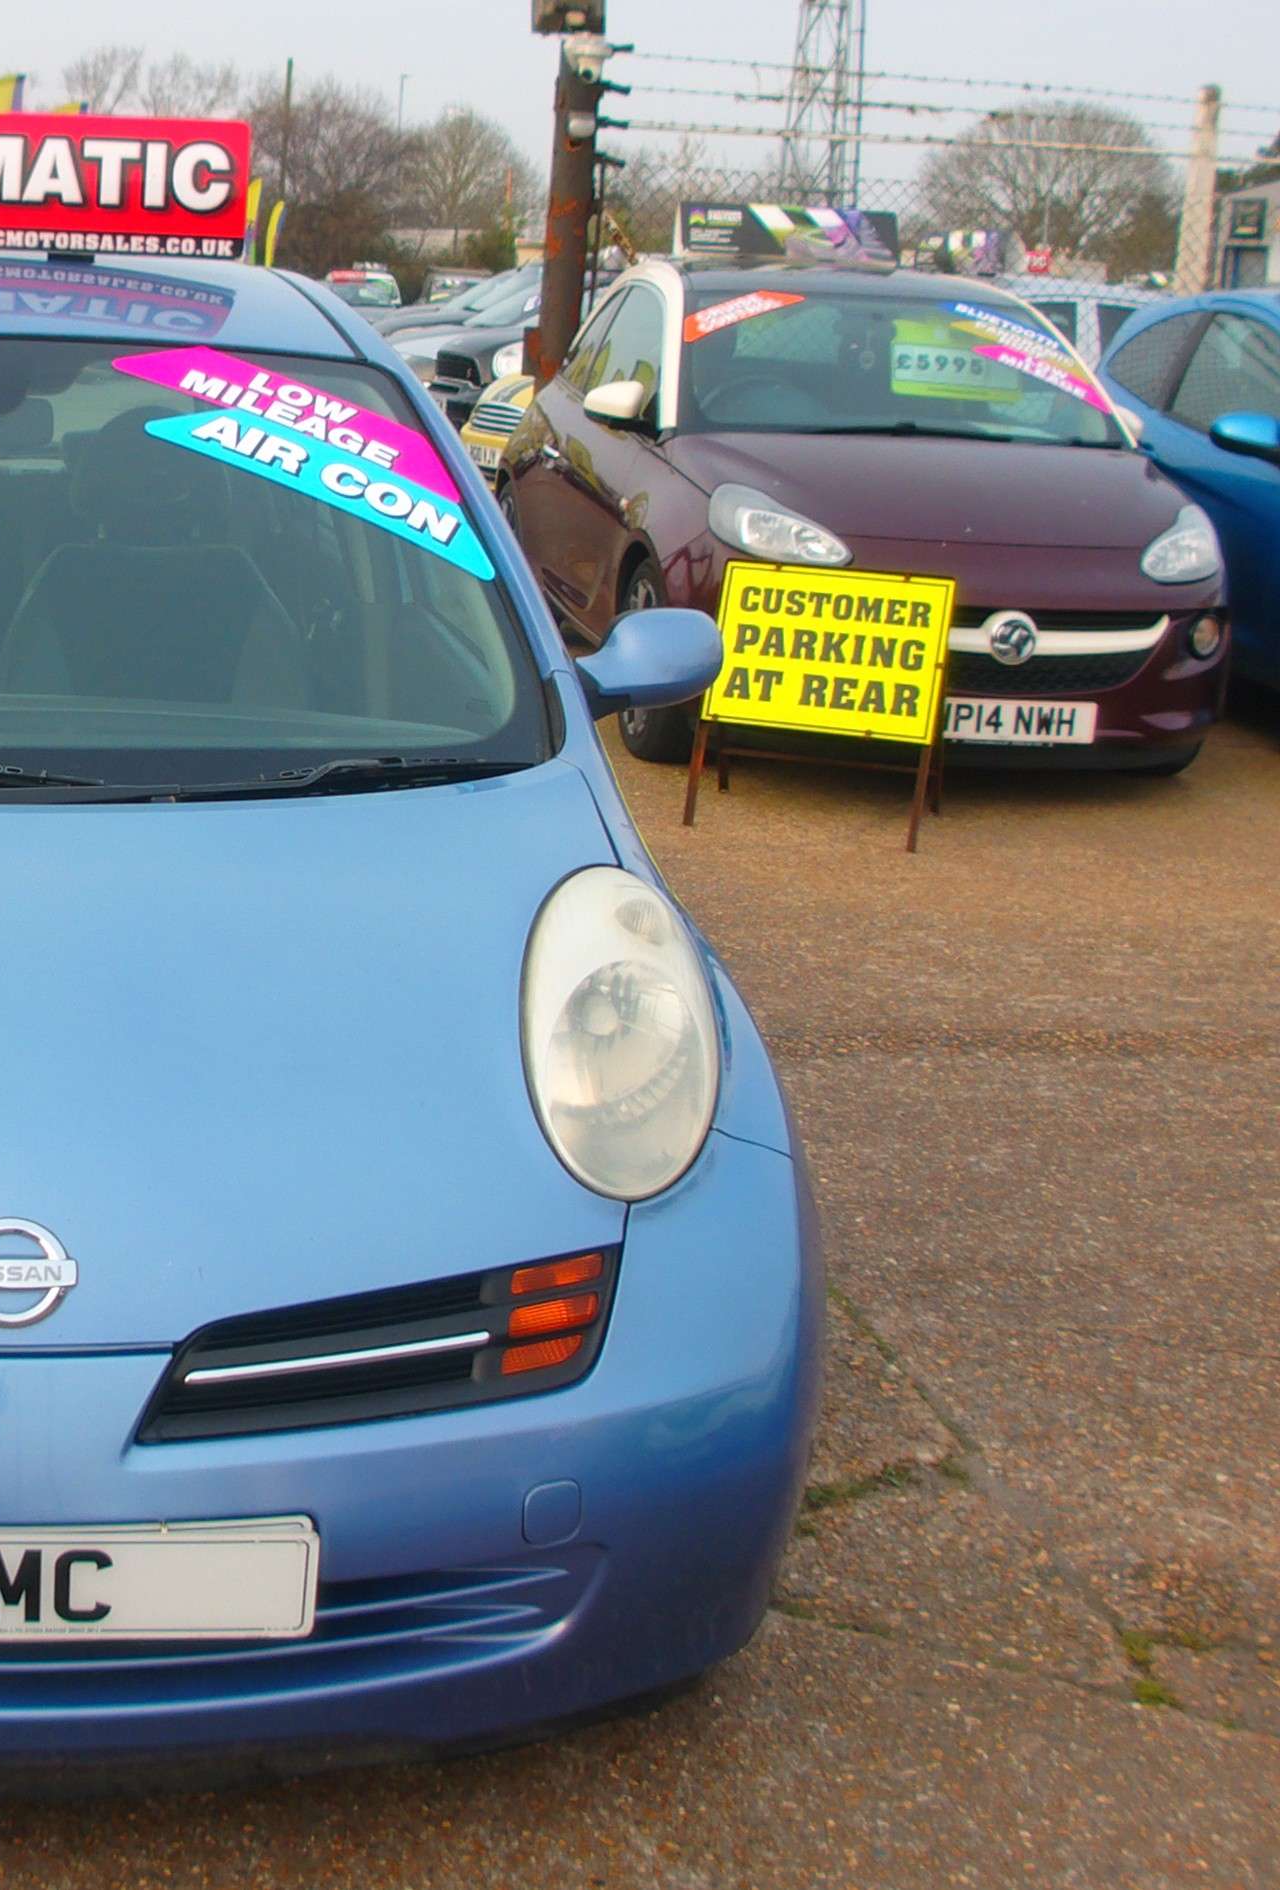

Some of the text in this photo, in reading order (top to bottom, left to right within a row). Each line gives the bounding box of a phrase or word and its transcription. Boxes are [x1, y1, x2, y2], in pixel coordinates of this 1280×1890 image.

[954, 302, 1060, 350] BLUETOOTH
[179, 368, 401, 471] MILEAGE
[247, 371, 359, 425] LOW
[191, 415, 462, 546] AIR CON
[739, 585, 932, 628] CUSTOMER
[733, 623, 927, 671] PARKING
[722, 666, 921, 718] AT REAR
[1014, 705, 1077, 737] NWH
